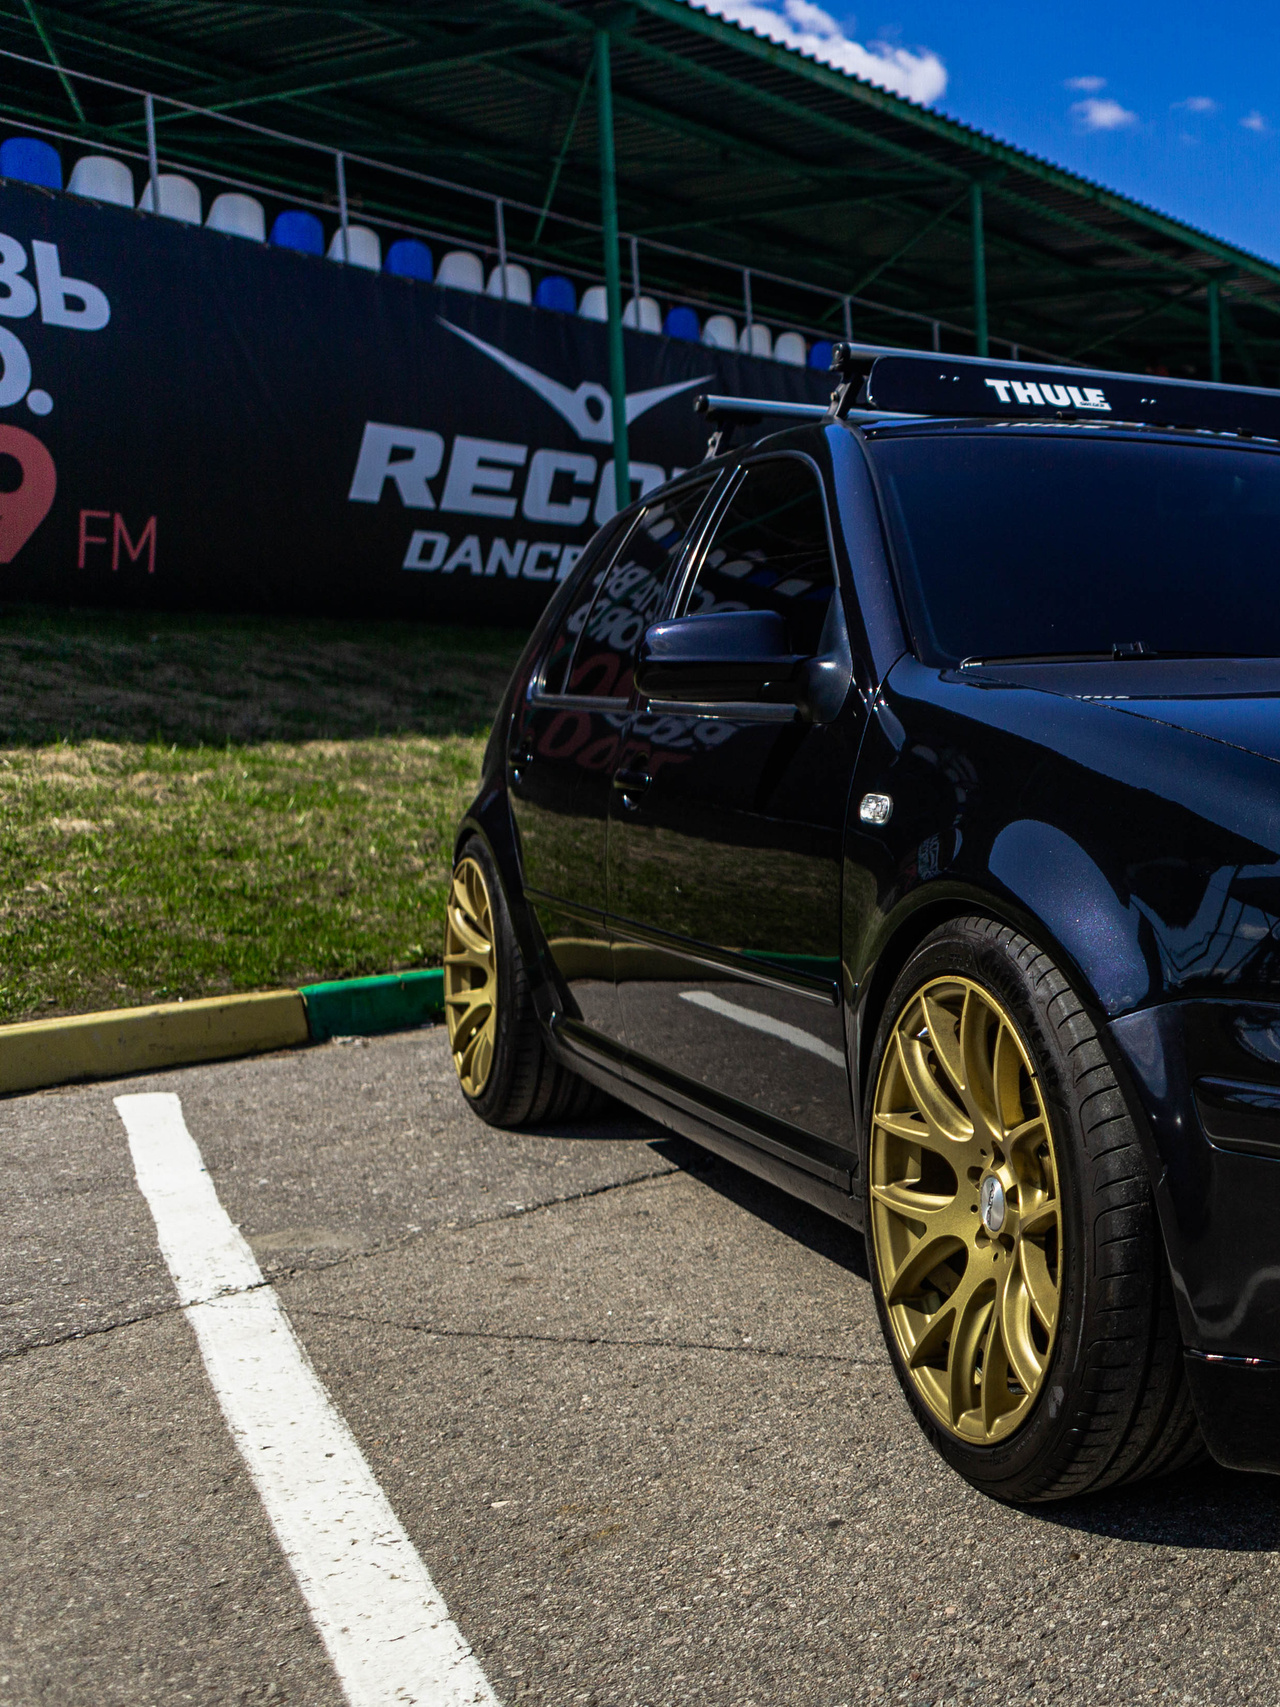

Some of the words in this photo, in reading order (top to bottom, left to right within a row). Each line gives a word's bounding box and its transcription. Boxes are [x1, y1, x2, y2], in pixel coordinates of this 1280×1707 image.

[984, 378, 1112, 411] THULE
[348, 420, 688, 526] RECO
[78, 508, 157, 573] FM
